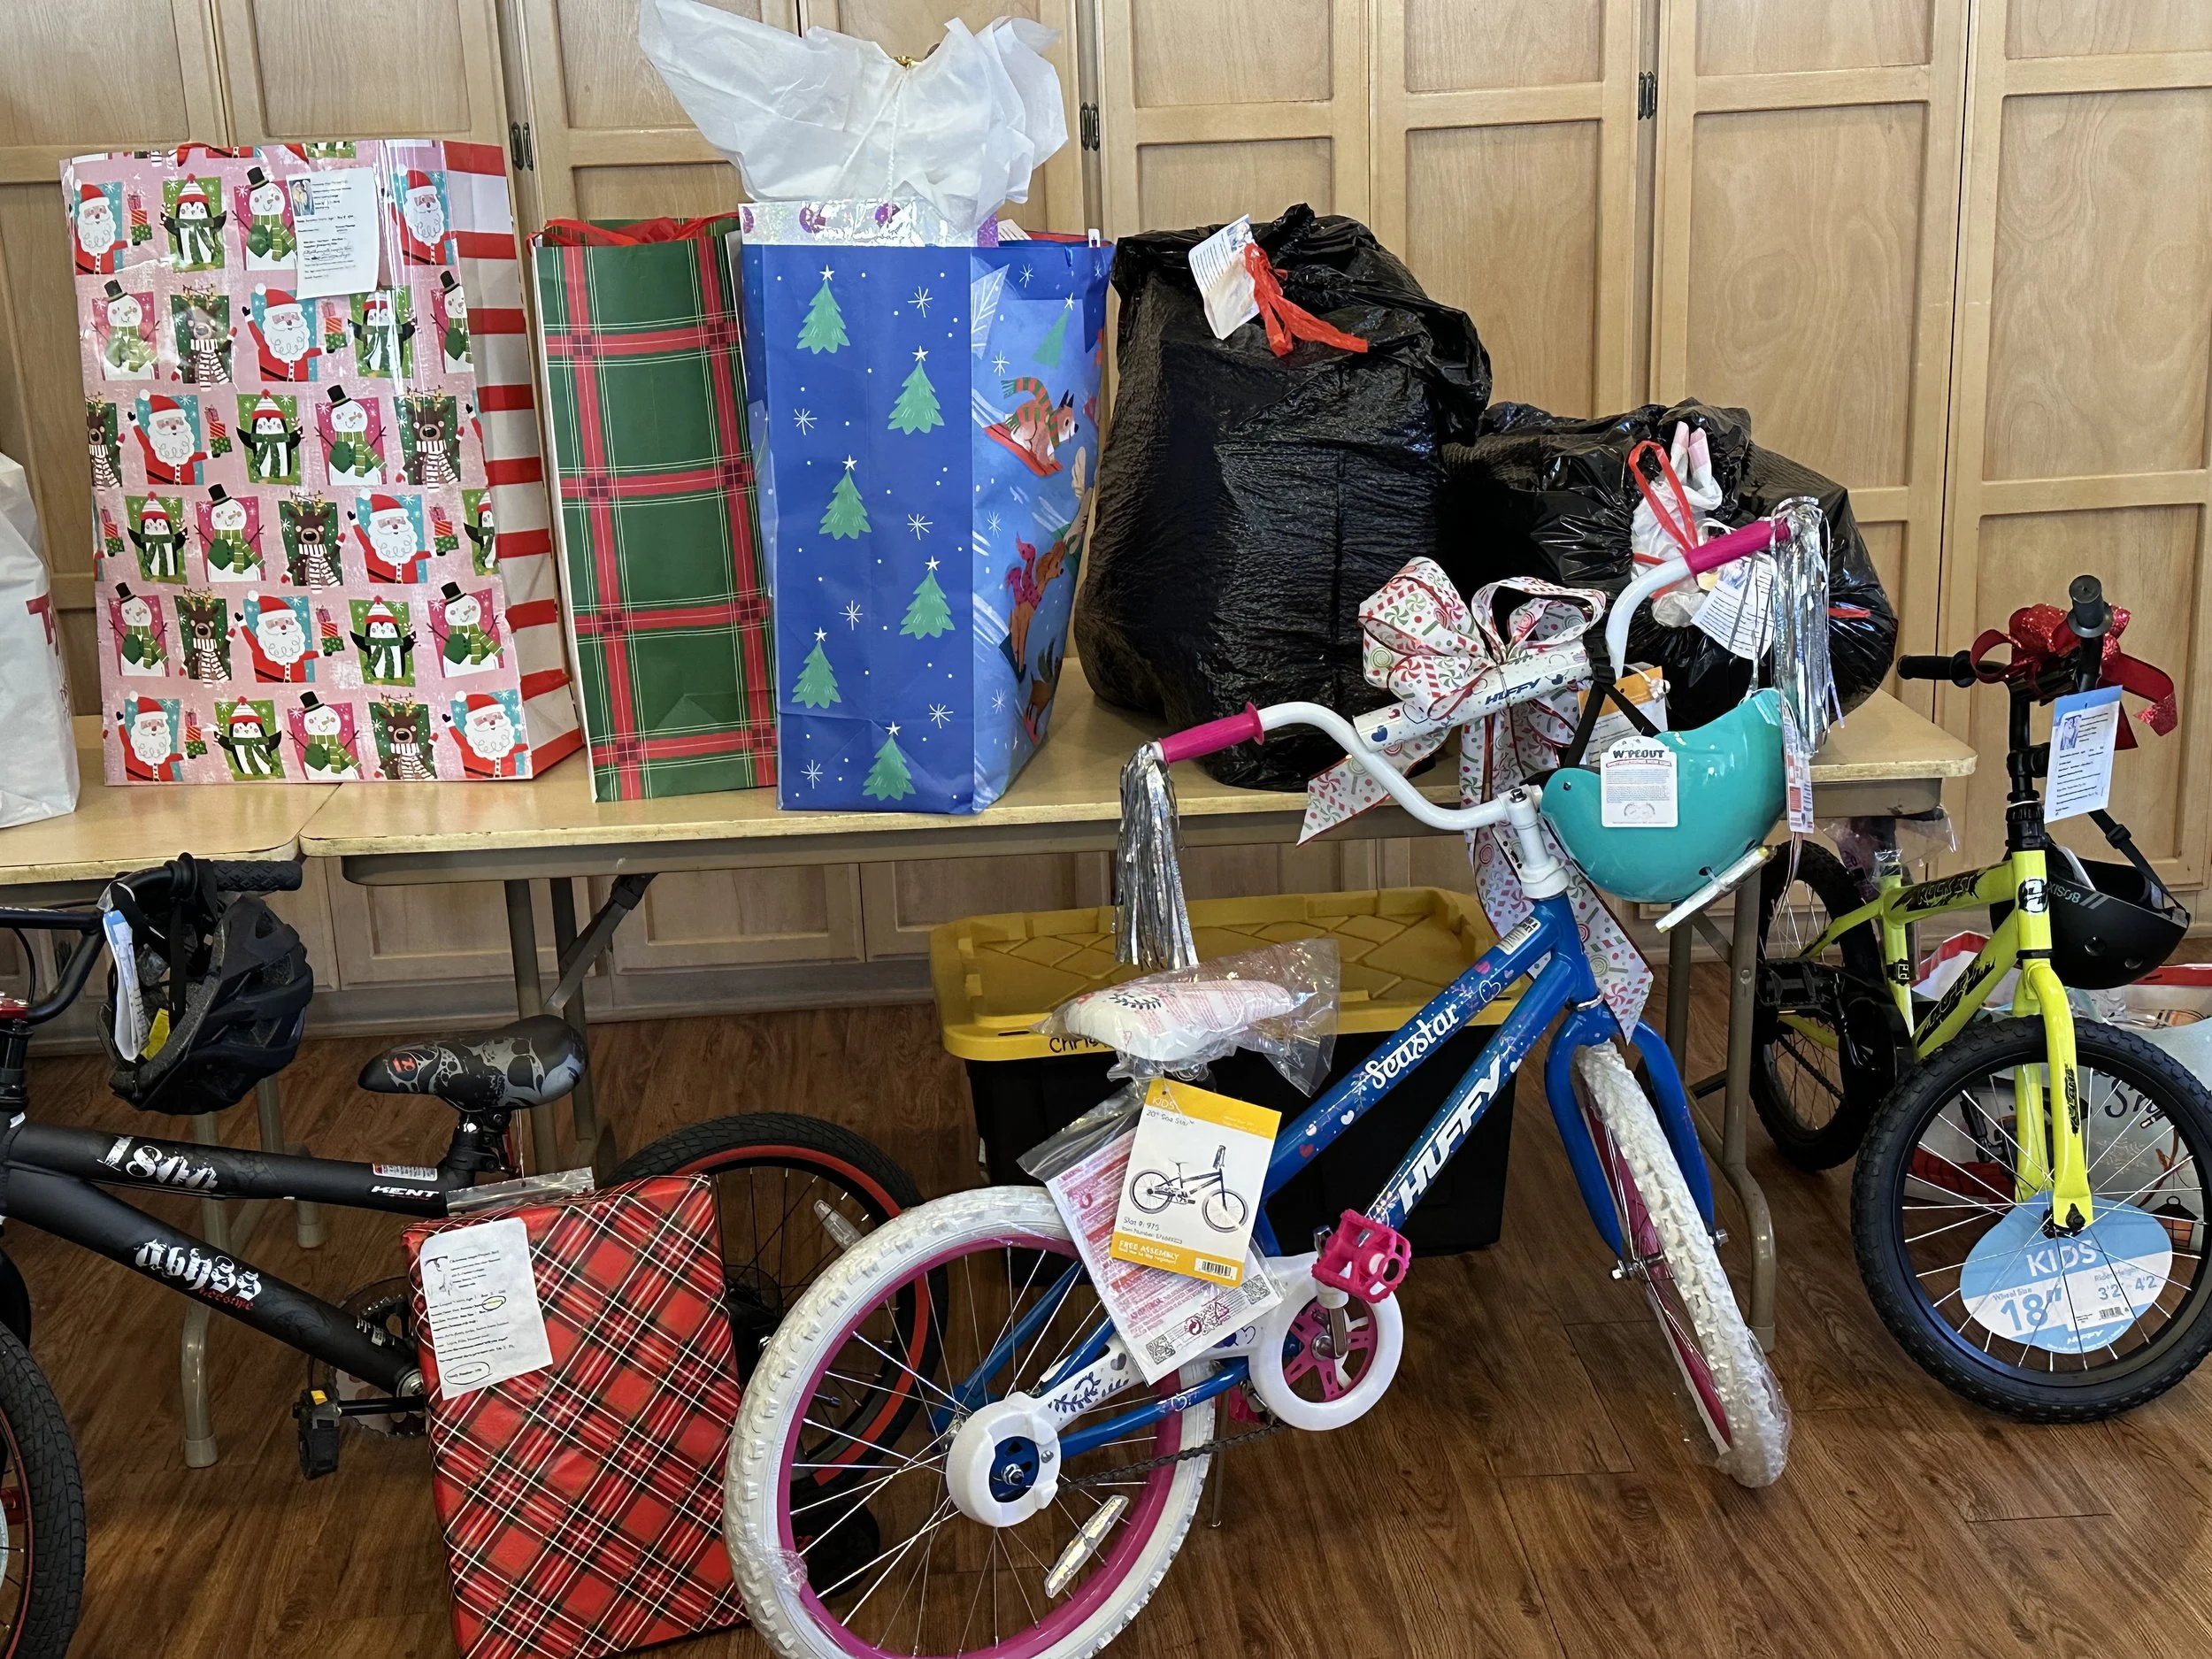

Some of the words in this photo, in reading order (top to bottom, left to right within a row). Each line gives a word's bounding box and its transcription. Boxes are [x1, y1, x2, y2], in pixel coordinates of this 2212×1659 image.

[1485, 677, 1541, 705] HUFFY
[1613, 749, 1664, 758] WPEOUT
[1365, 1004, 1460, 1089] Seastar
[1152, 1096, 1176, 1110] KIDS
[1398, 1053, 1502, 1215] HUFFY
[371, 1186, 440, 1197] KENT
[2026, 1240, 2097, 1277] KIDS
